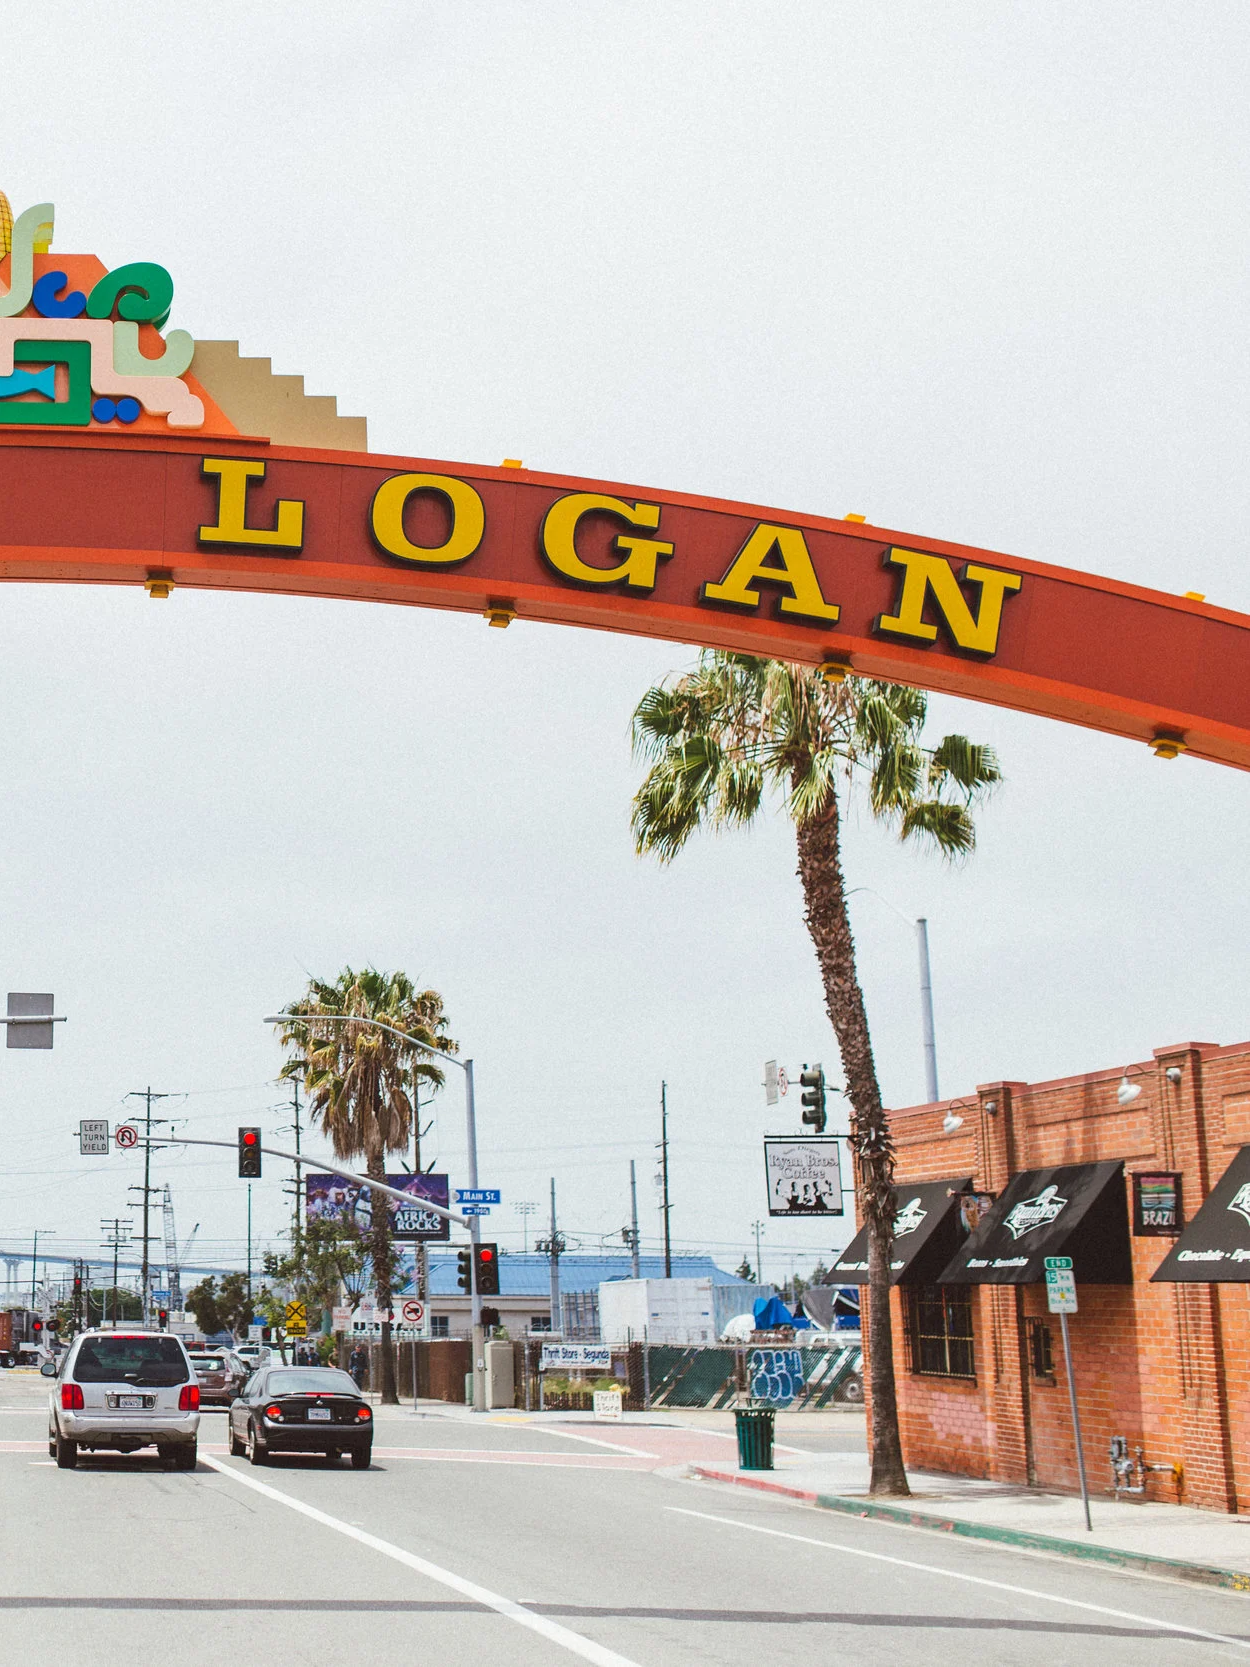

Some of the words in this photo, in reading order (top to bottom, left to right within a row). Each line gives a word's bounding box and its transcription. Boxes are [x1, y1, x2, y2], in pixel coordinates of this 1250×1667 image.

[196, 456, 1023, 659] LOGAN
[84, 1133, 105, 1141] TURN
[82, 1143, 107, 1151] YIELD
[769, 1154, 803, 1170] Ryan
[782, 1167, 826, 1180] Coffee
[394, 1211, 441, 1221] AFRICA
[396, 1220, 442, 1231] ROCKS
[1051, 1259, 1067, 1267] END
[1047, 1271, 1057, 1283] 15
[543, 1347, 559, 1359] Thrift
[561, 1347, 578, 1359] Store
[583, 1347, 610, 1362] Segunda
